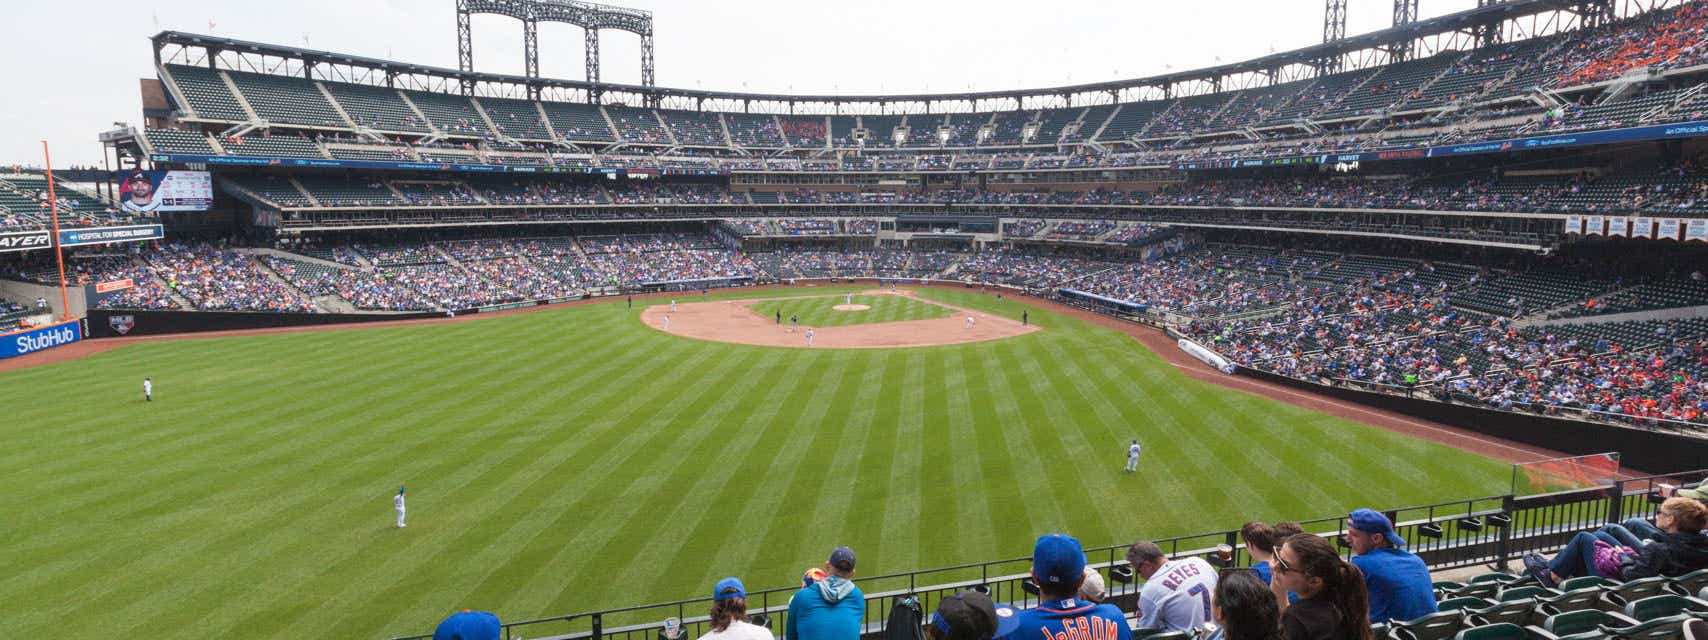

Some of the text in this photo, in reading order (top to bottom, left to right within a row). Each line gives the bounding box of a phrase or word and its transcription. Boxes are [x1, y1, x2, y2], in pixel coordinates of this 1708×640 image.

[16, 327, 74, 353] StubHub
[1162, 563, 1201, 591] REYES
[1187, 582, 1212, 622] 7
